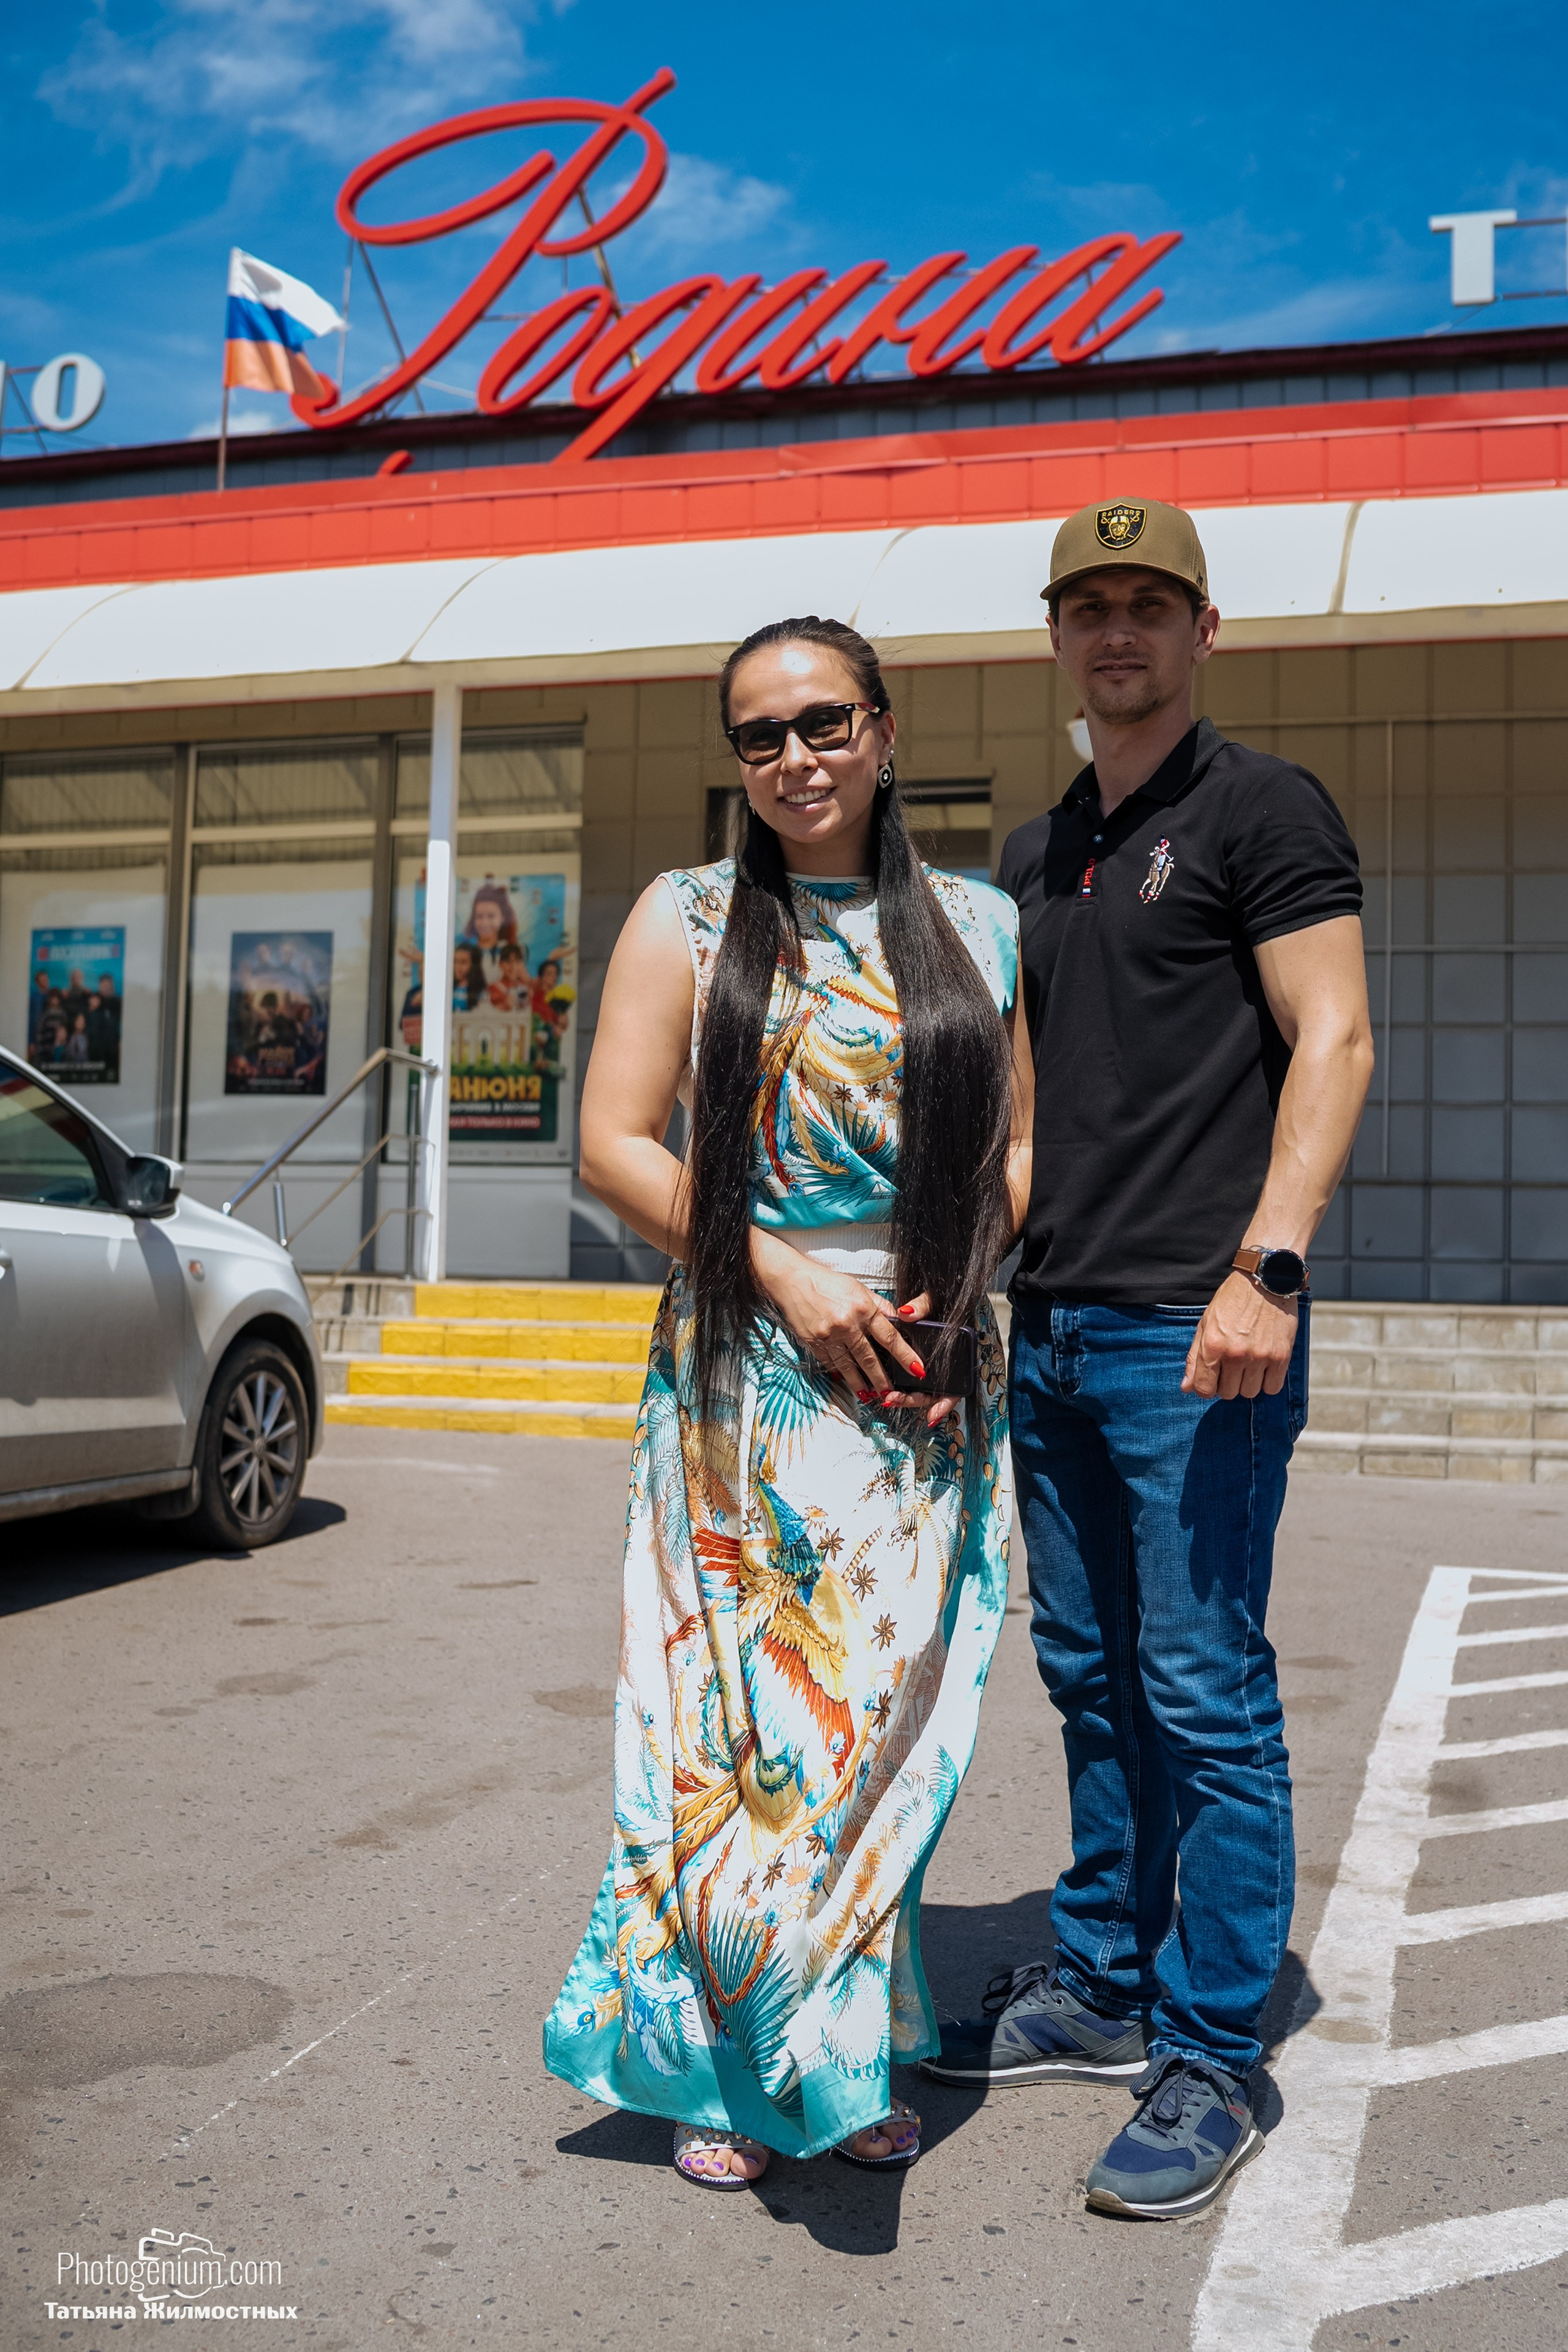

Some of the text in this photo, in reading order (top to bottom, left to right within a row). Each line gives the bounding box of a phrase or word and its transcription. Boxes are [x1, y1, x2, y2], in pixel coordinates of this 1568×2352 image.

[290, 66, 1183, 472] Родина
[1428, 208, 1568, 307] Т
[1102, 509, 1141, 518] RAIDERS
[1084, 858, 1096, 886] POLO
[450, 1075, 541, 1101] АНЮНЯ
